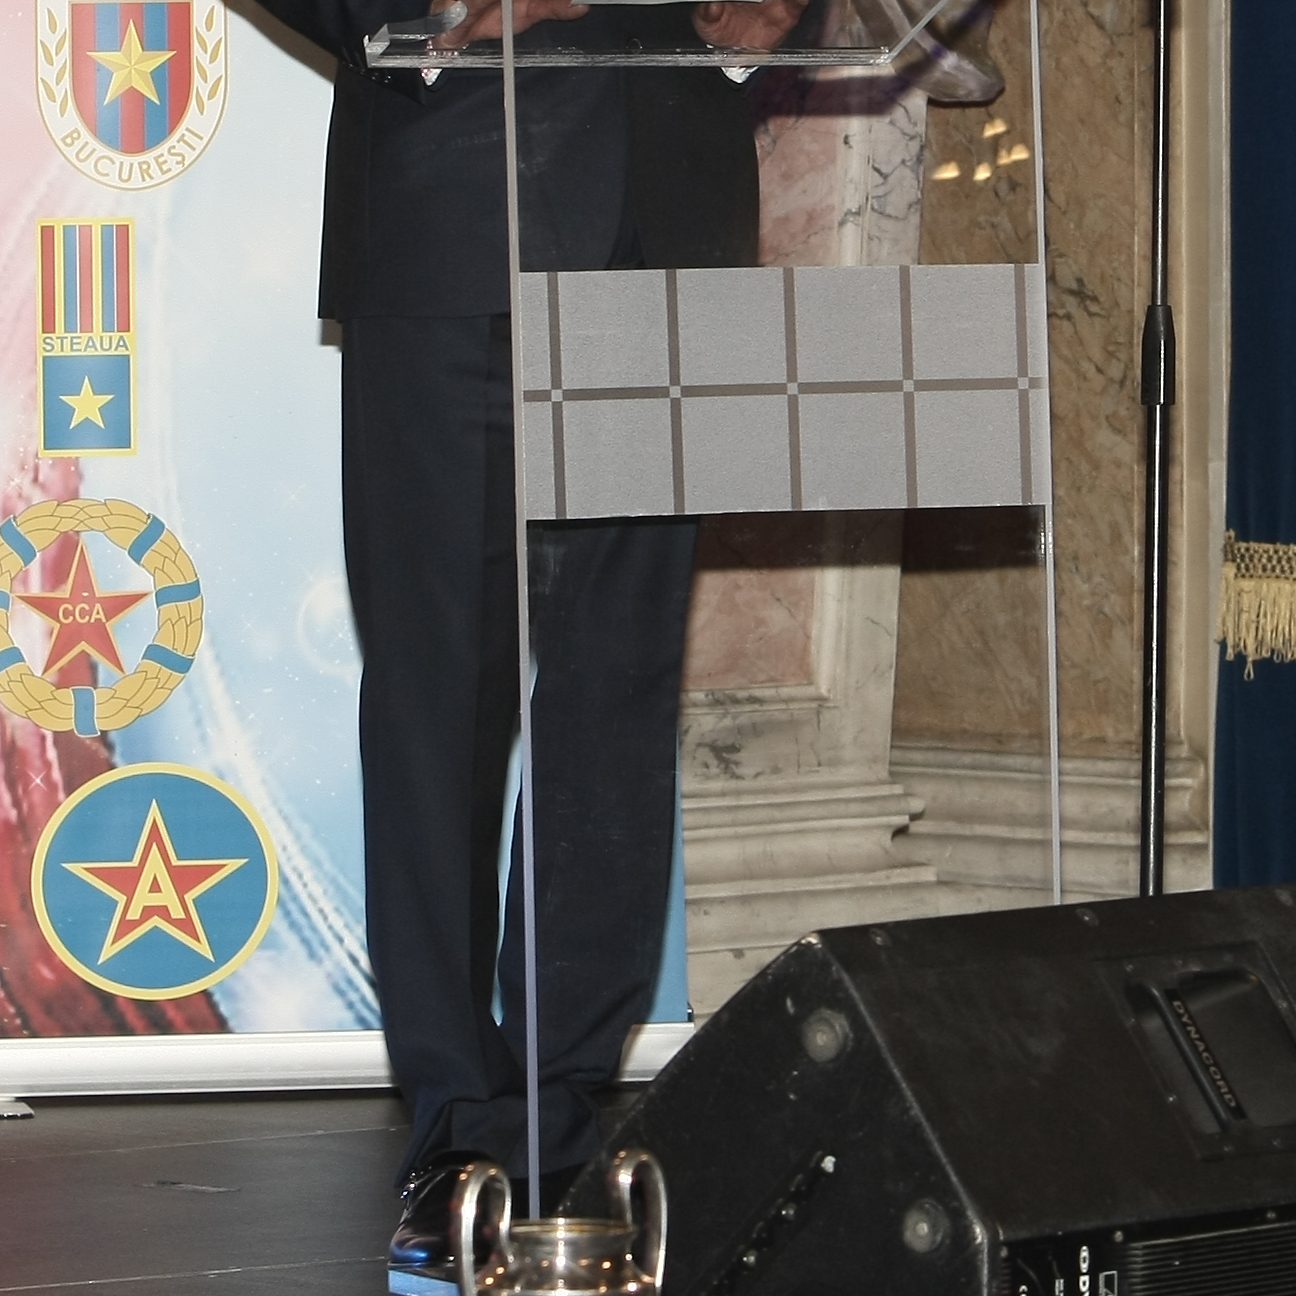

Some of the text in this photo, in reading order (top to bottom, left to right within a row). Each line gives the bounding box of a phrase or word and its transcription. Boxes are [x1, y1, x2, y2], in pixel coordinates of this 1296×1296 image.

[41, 336, 130, 353] STEAUA
[57, 603, 107, 624] CCA
[125, 841, 187, 920] A
[1171, 1000, 1238, 1109] DYNACORD
